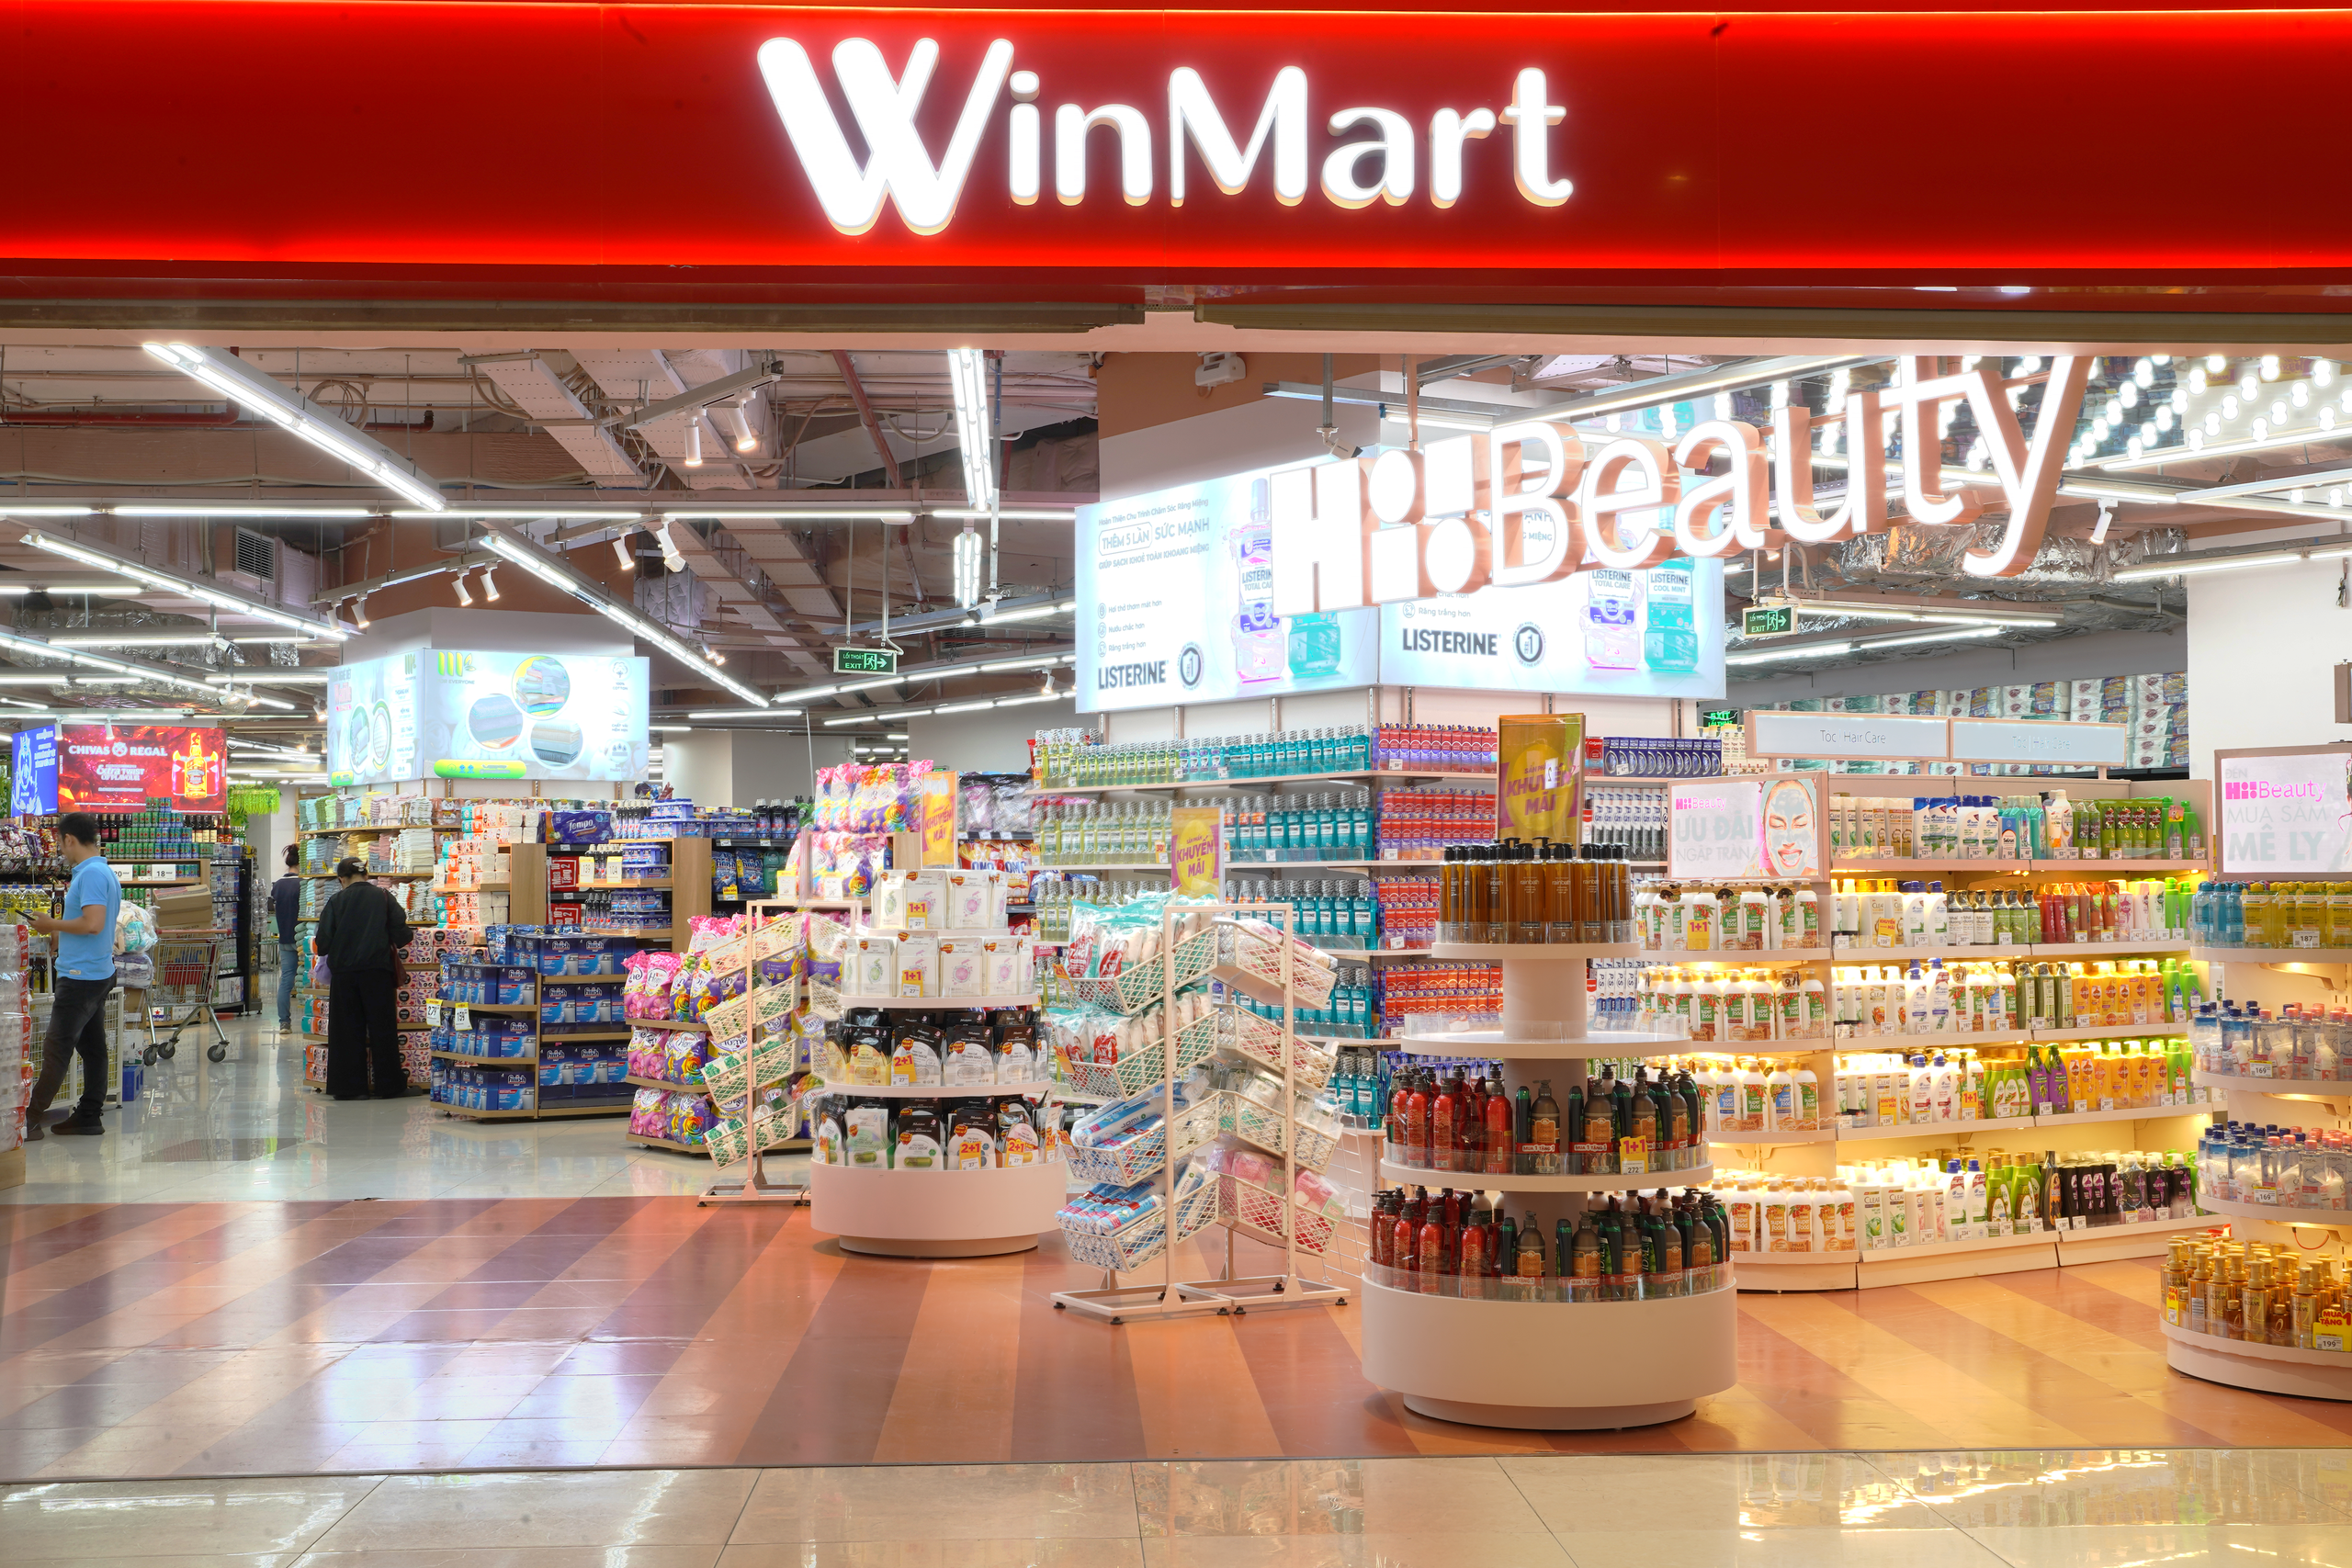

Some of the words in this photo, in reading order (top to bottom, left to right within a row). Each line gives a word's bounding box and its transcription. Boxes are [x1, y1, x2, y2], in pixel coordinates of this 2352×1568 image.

[757, 37, 1574, 236] WinMart
[1126, 513, 1136, 522] Chu
[1102, 534, 1124, 549] THÊM
[1126, 534, 1130, 545] 5
[1132, 527, 1149, 545] LẦN
[1155, 523, 1175, 540] SỨC
[1178, 518, 1209, 537] MẠNH
[1529, 532, 1552, 541] MIỆNG
[1163, 548, 1189, 558] KHOANG
[1595, 580, 1612, 588] TOTAL
[1615, 581, 1631, 590] CARE
[1651, 573, 1689, 585] LISTERINE
[1419, 608, 1436, 616] Răng
[1438, 607, 1455, 617] trắng
[1458, 609, 1471, 617] hơn
[1403, 627, 1498, 656] LISTERINE
[1098, 660, 1166, 690] LISTERINE
[1711, 711, 1730, 719] EXIT
[1820, 729, 1837, 744] Tóc
[1845, 732, 1862, 744] Hair
[1865, 732, 1886, 745] Care
[69, 745, 109, 755] CHIVAS
[130, 746, 167, 757] REGAL
[1525, 791, 1556, 816] MÃI
[2227, 806, 2274, 823] MUA
[2280, 799, 2327, 822] SẮM
[566, 819, 594, 831] Tempo
[1676, 814, 1706, 842] ƯU
[1713, 810, 1753, 840] ĐÃI
[2228, 823, 2276, 862] MÊ
[2290, 831, 2325, 861] LY
[1176, 836, 1214, 863] KHUYẾN
[1676, 845, 1713, 863] NGẬP
[1188, 862, 1205, 878] MÃI
[552, 872, 561, 885] Mua
[909, 904, 925, 912] 1+1
[1690, 921, 1708, 932] 1+1
[904, 972, 922, 980] 1+1
[894, 1055, 913, 1066] 2+1
[1963, 1093, 1978, 1104] 1+1
[1046, 1135, 1055, 1145] 2+1
[1623, 1138, 1646, 1154] 1+1
[961, 1144, 980, 1153] 2+1
[1008, 1144, 1024, 1153] 2+1
[2342, 1313, 2351, 1325] 1
